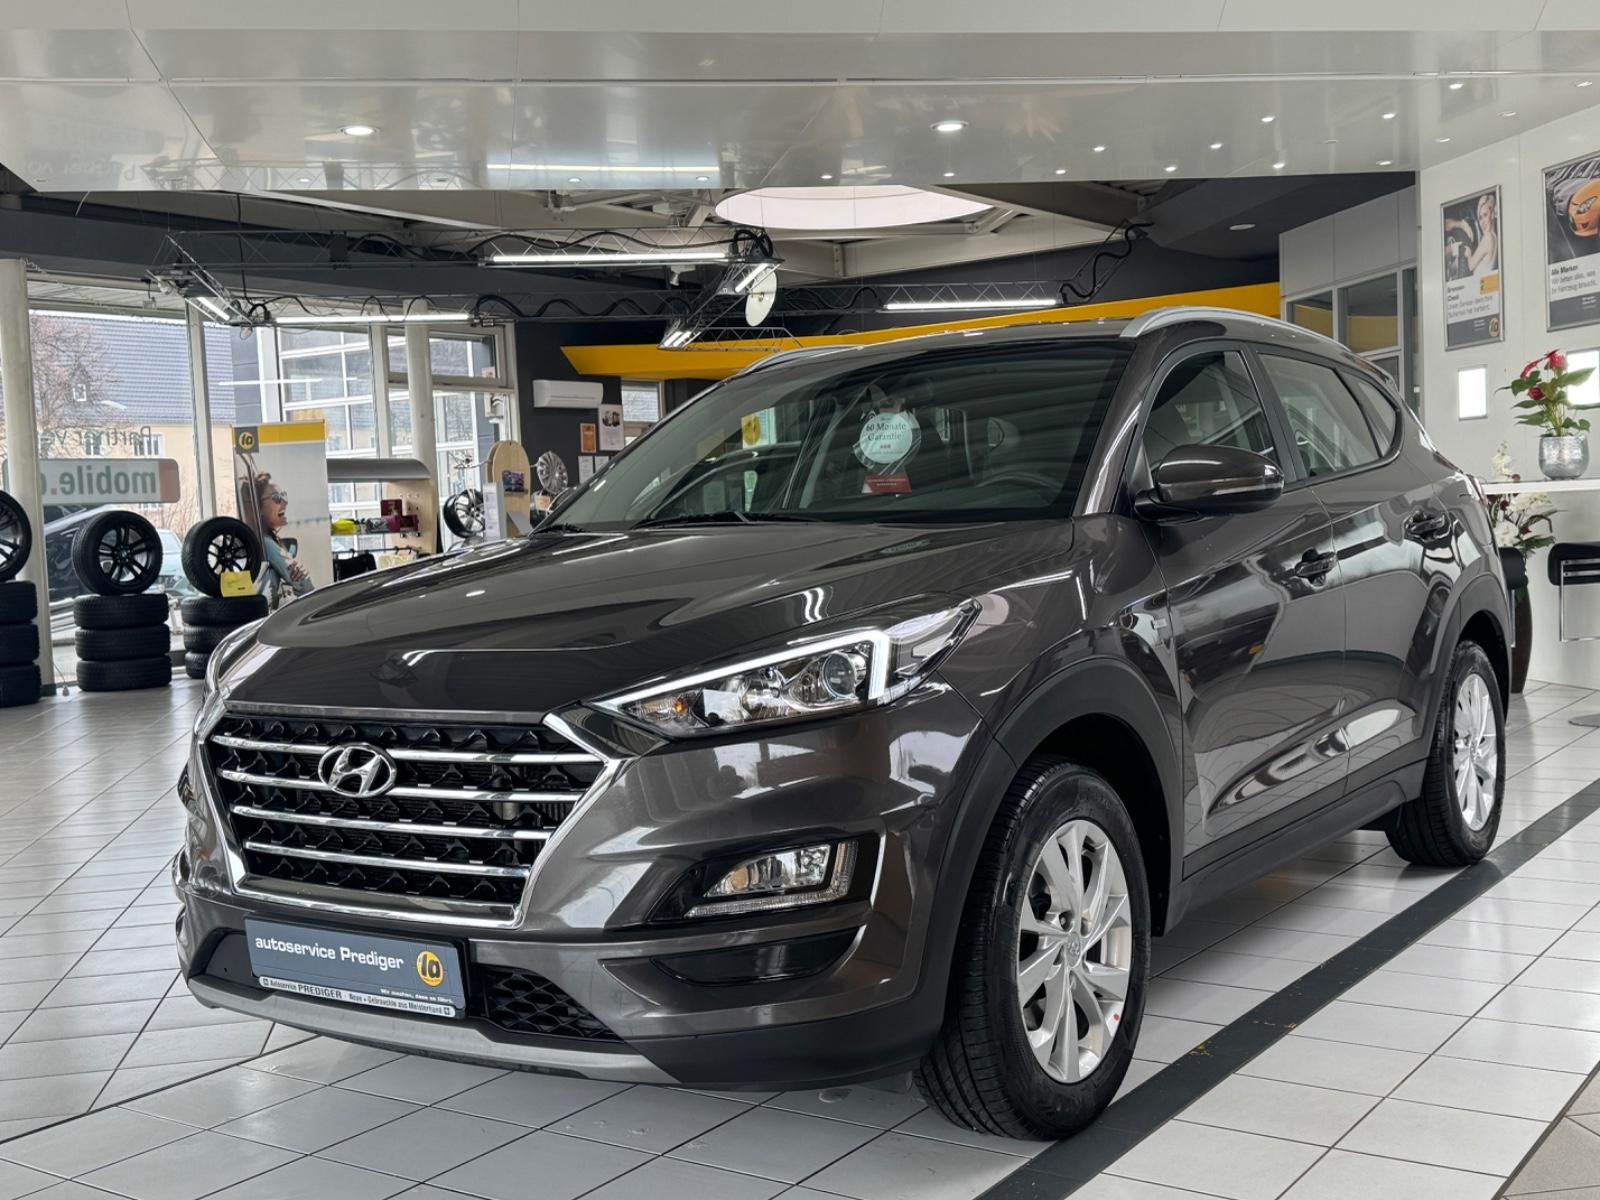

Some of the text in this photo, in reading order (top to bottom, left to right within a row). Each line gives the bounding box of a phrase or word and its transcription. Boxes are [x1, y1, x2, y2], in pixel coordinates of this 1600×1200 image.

[876, 422, 906, 430] Monate
[255, 936, 404, 971] autoservice Prediger
[298, 984, 342, 999] PREDIGER
